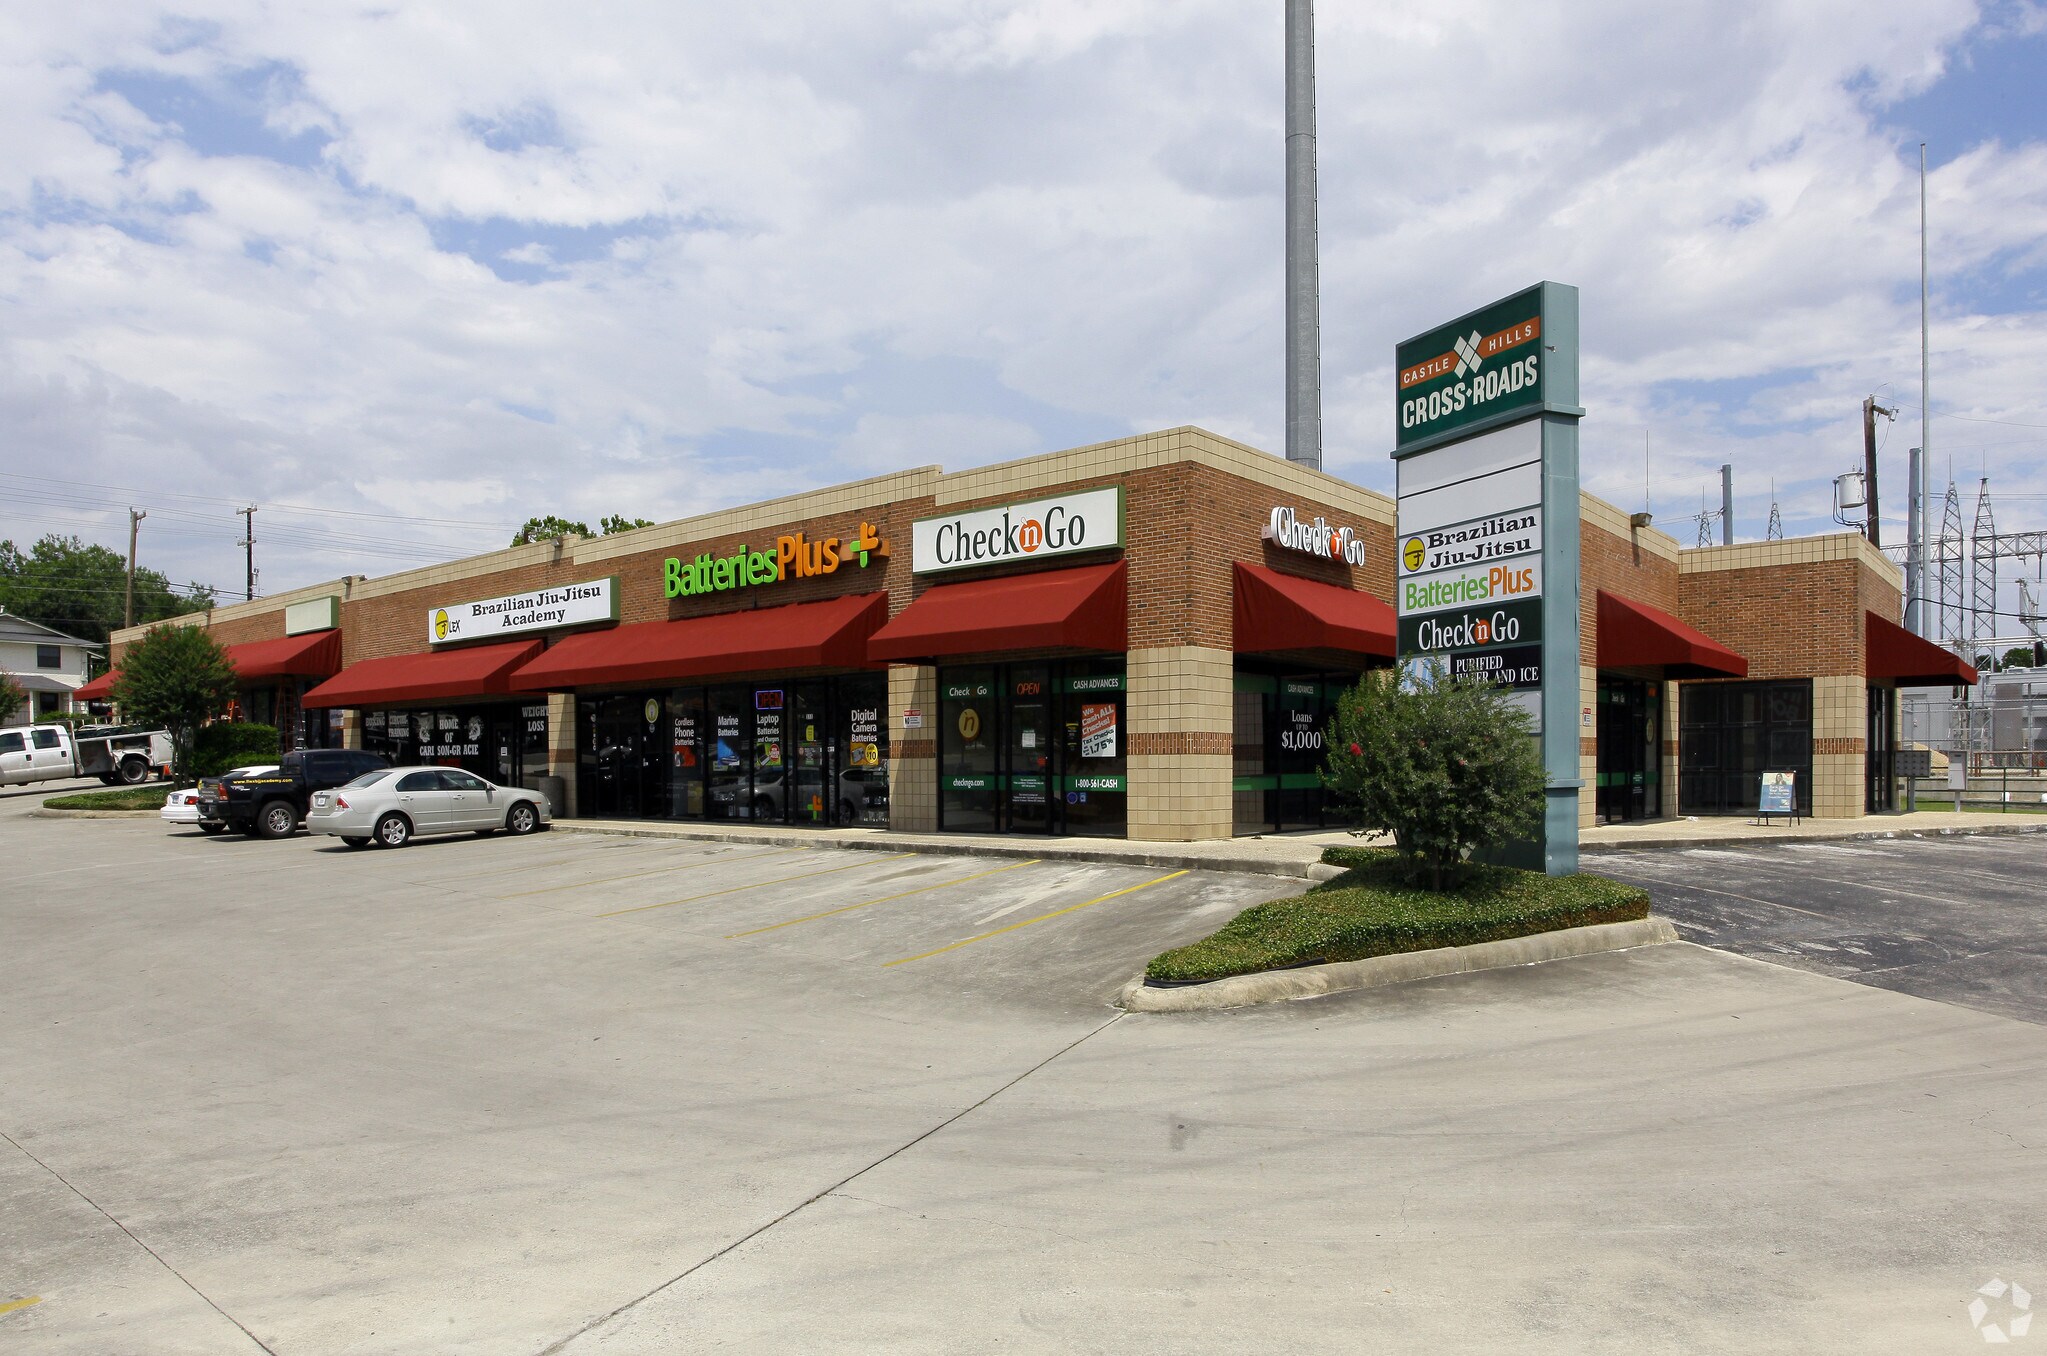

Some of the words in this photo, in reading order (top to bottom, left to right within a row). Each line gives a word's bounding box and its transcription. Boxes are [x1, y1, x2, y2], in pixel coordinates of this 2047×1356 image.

[1404, 358, 1449, 384] CASTLE
[1489, 325, 1532, 351] HILLS
[1427, 515, 1536, 549] Brazilian
[1430, 538, 1532, 569] Jiu-Jitsu
[472, 598, 534, 617] Brazilian
[536, 585, 601, 607] Jiu-Jitsu
[502, 609, 566, 627] Academy
[1456, 655, 1503, 673] PURIFIED
[1494, 668, 1516, 683] AND
[1520, 667, 1539, 682] ICE
[1016, 682, 1040, 695] OPEN
[1073, 680, 1088, 689] CASH
[1088, 678, 1119, 688] ADVANCES
[1288, 684, 1298, 693] CASH
[949, 687, 970, 697] Check
[977, 686, 987, 695] Go
[522, 705, 549, 718] WEIGHT
[851, 709, 877, 723] Digital
[1082, 714, 1100, 726] Cash
[1099, 705, 1115, 719] ALL
[1291, 710, 1313, 723] Loans
[439, 719, 459, 730] HOME
[674, 718, 694, 726] Cordless
[718, 716, 739, 726] Marine
[757, 714, 779, 725] Laptop
[528, 721, 545, 732] LOSS
[674, 727, 694, 737] Phone
[718, 728, 739, 736] Batteries
[757, 727, 779, 735] Batteries
[851, 723, 877, 733] Camera
[444, 732, 454, 743] OF
[674, 738, 694, 746] Batteries
[851, 734, 877, 742] Batteries
[1082, 737, 1094, 745] Tax
[1093, 728, 1115, 741] Checks
[1281, 730, 1321, 751] $1,000
[953, 778, 984, 788] checkngo.com
[1075, 779, 1118, 788] 1-800-561-CASH
